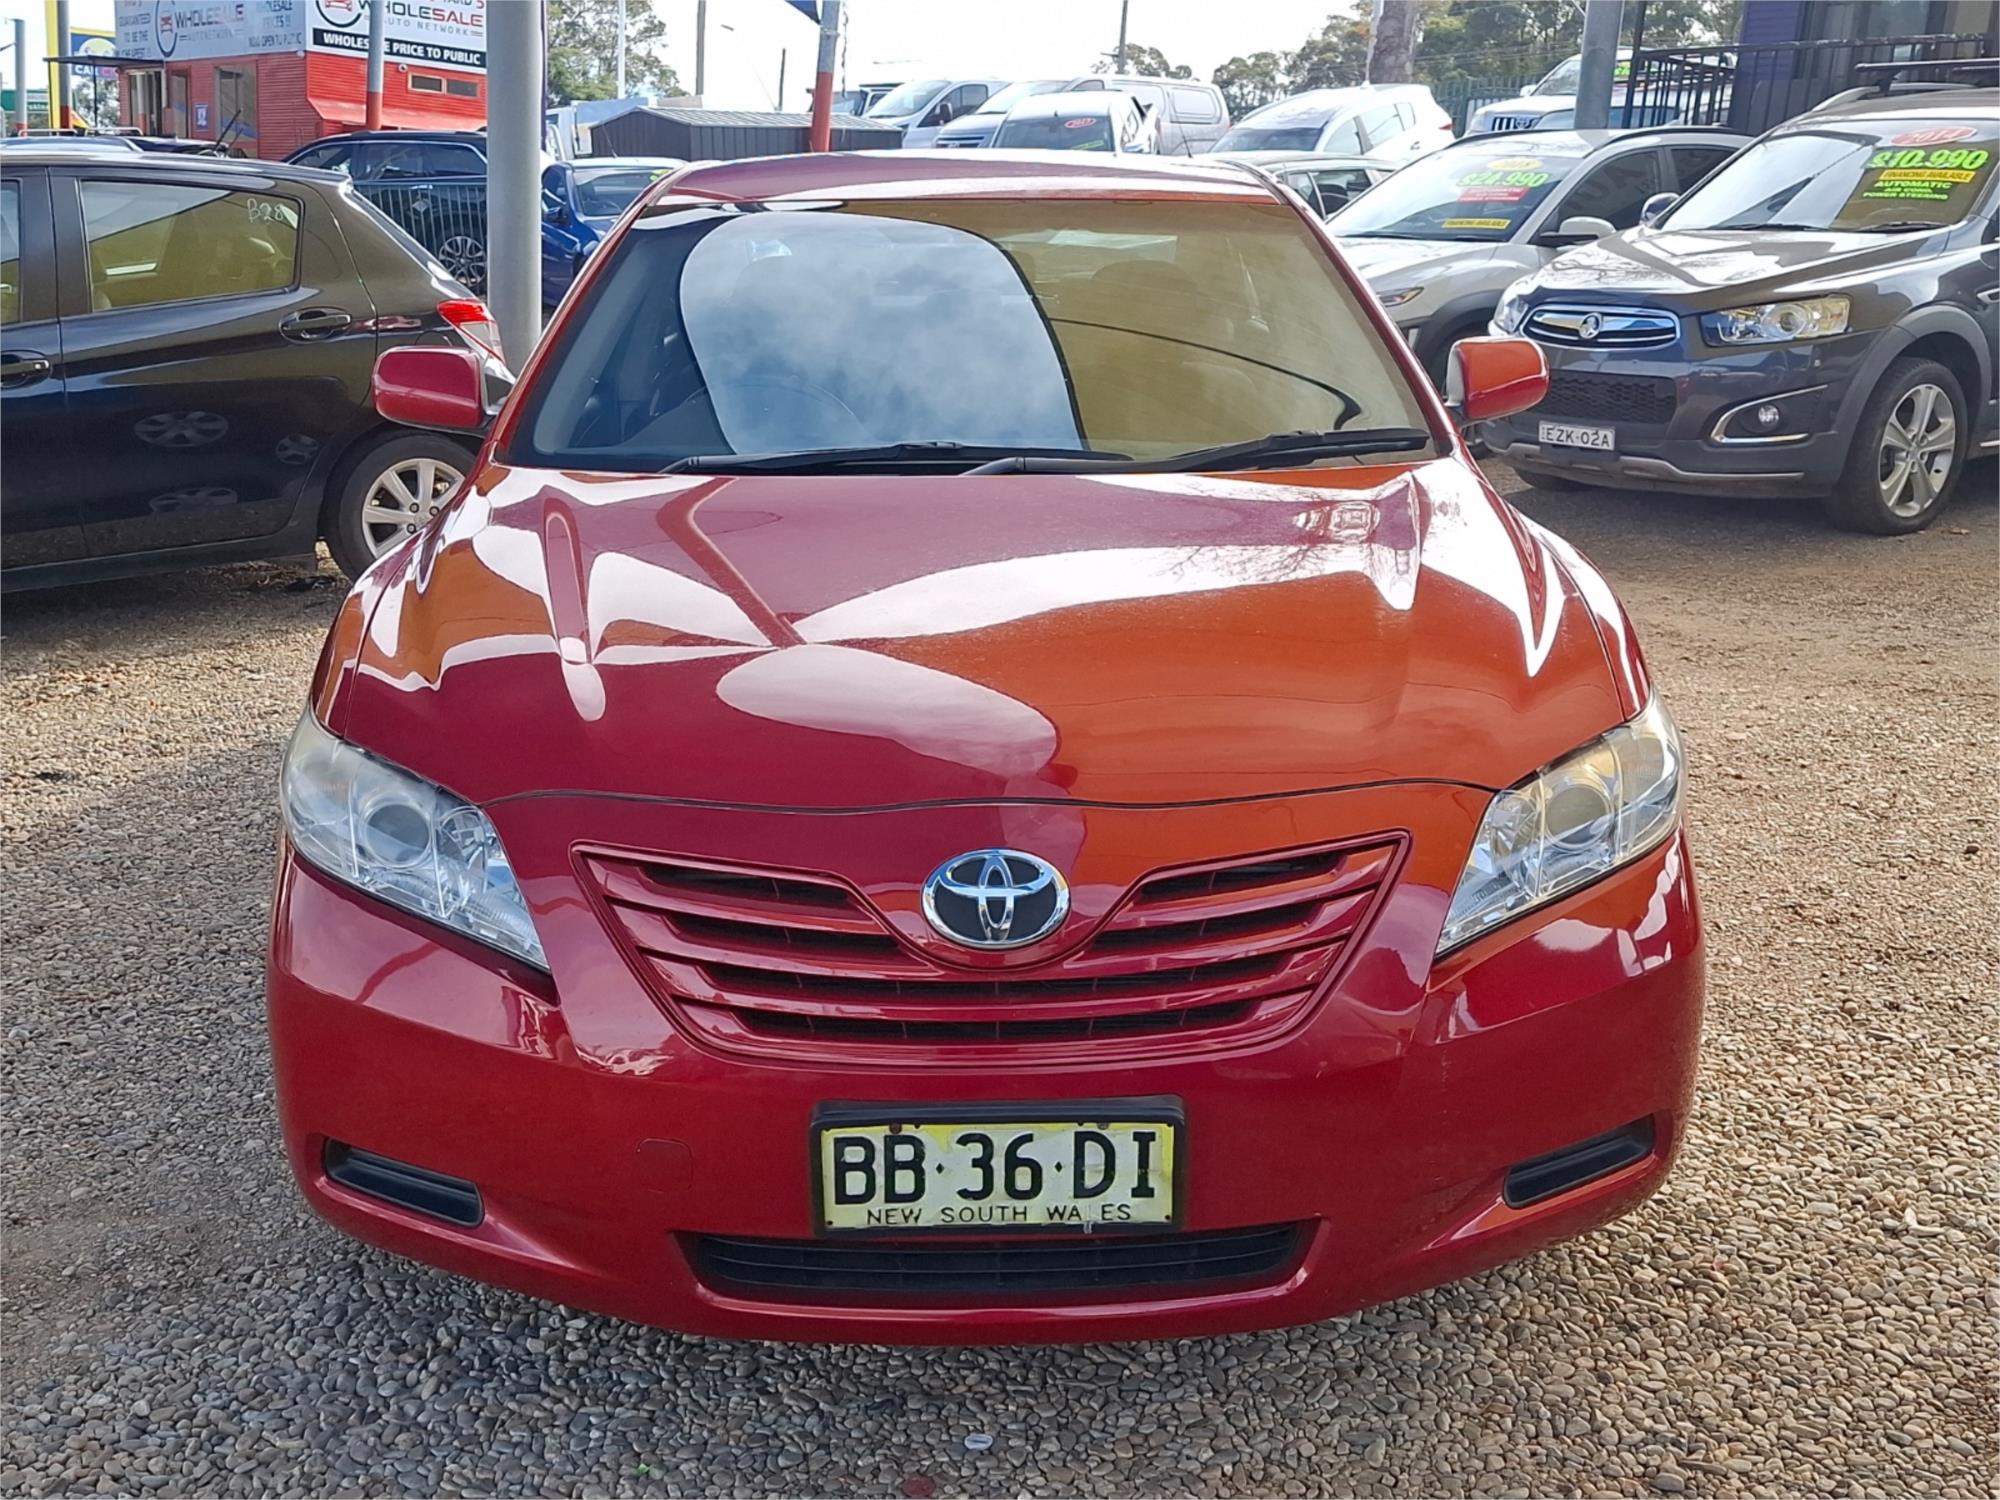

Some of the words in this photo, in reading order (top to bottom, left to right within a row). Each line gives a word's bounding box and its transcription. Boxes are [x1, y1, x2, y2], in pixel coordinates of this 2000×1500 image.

[174, 4, 244, 29] WHOLESALE
[384, 17, 410, 27] UTO
[417, 21, 468, 36] NETWORK
[323, 33, 391, 51] WHOLESE
[392, 42, 424, 57] PRICE
[426, 47, 442, 58] TO
[443, 50, 481, 65] PUBLIC
[1874, 181, 1952, 189] AUTOMATIC
[866, 1209, 922, 1225] NEW
[940, 1207, 1028, 1223] SOUTH
[1046, 1203, 1132, 1221] WAES
